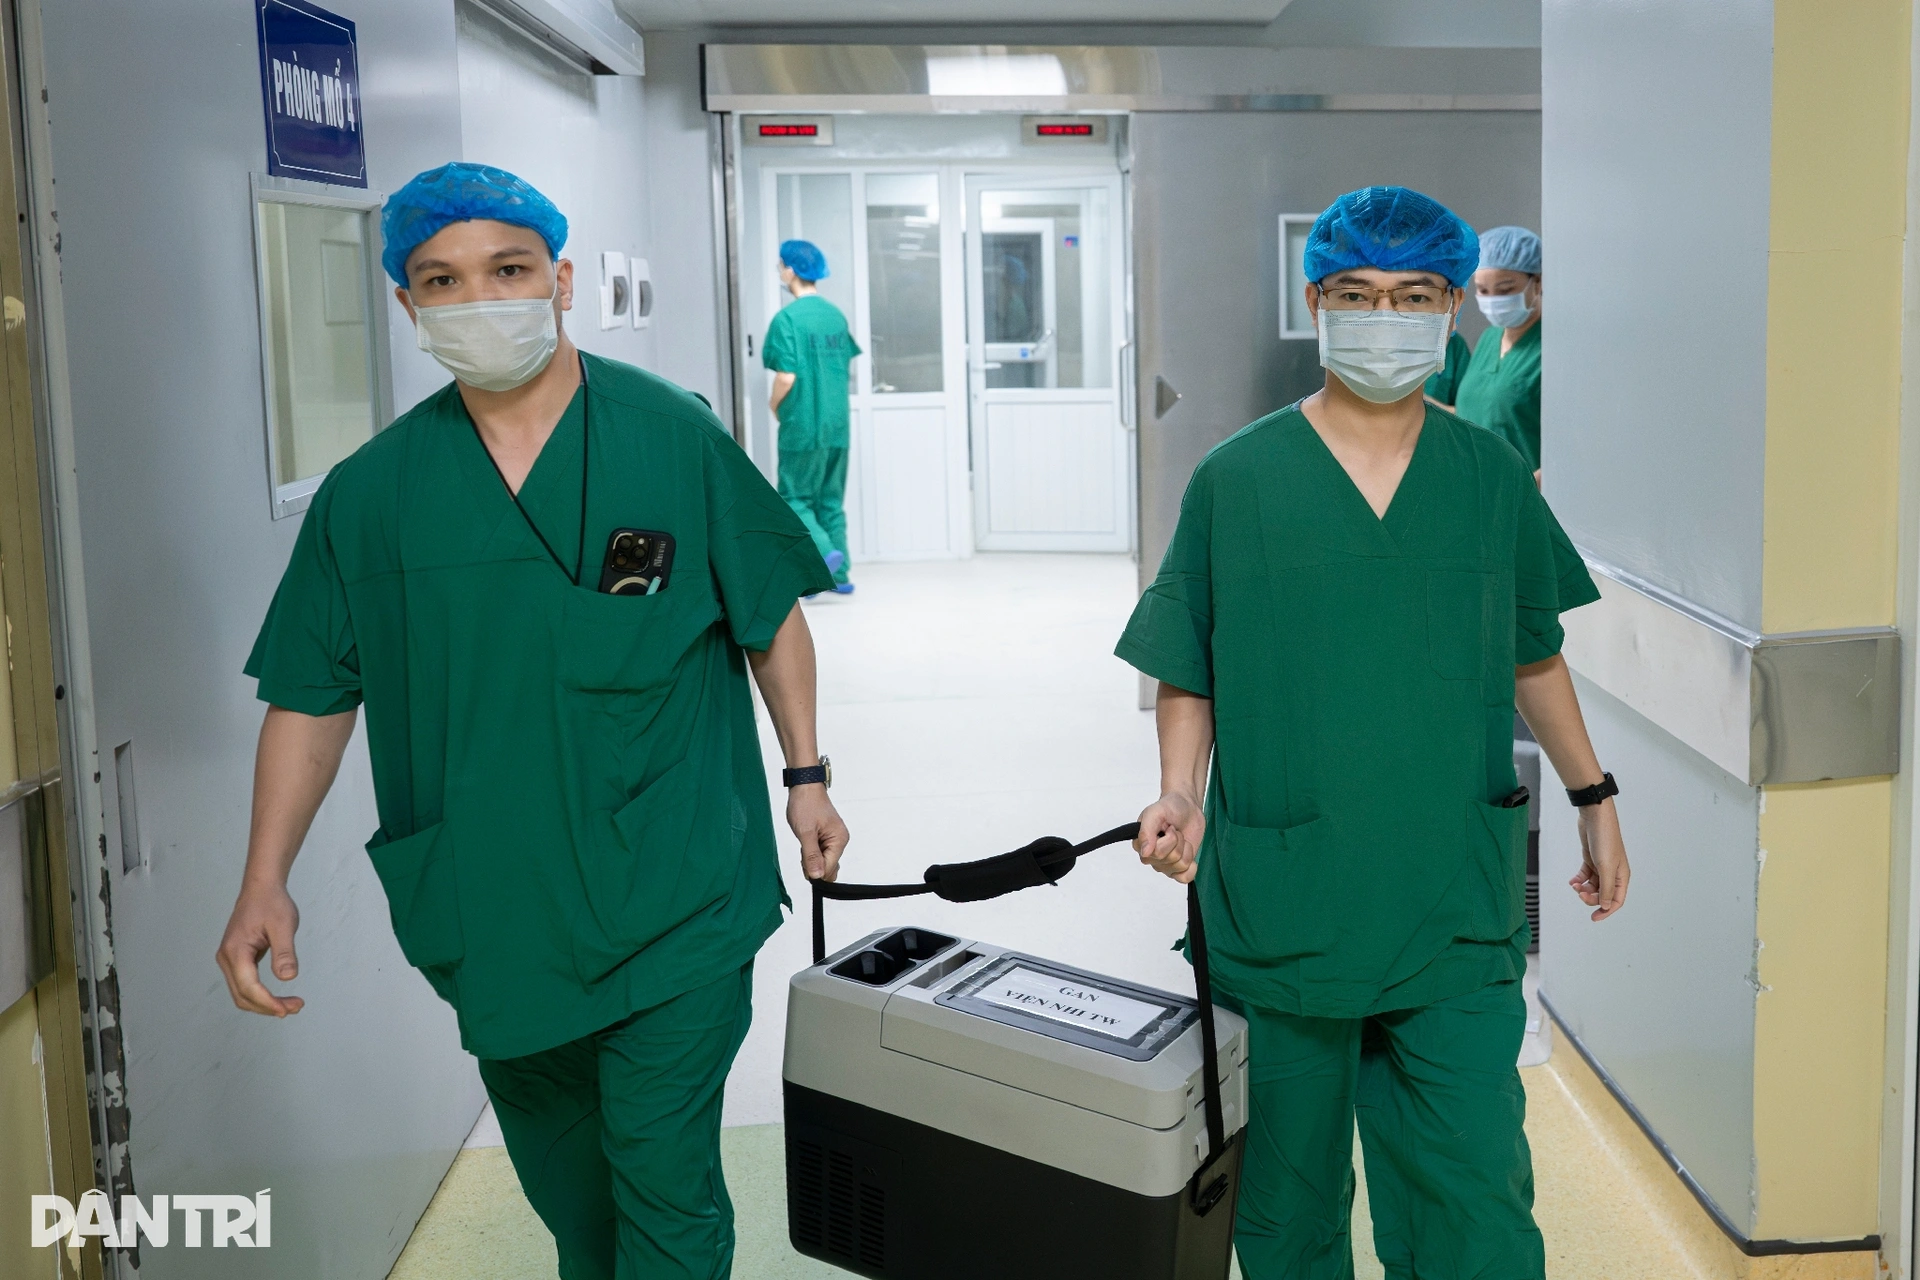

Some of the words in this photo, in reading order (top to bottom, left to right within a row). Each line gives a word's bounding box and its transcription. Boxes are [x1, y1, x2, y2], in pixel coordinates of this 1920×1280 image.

[273, 50, 322, 124] PHÒNG
[322, 58, 345, 129] MỔ
[346, 83, 356, 132] 4
[1059, 986, 1100, 1002] GAN
[1049, 1003, 1087, 1017] NHI
[1089, 1013, 1121, 1026] TW
